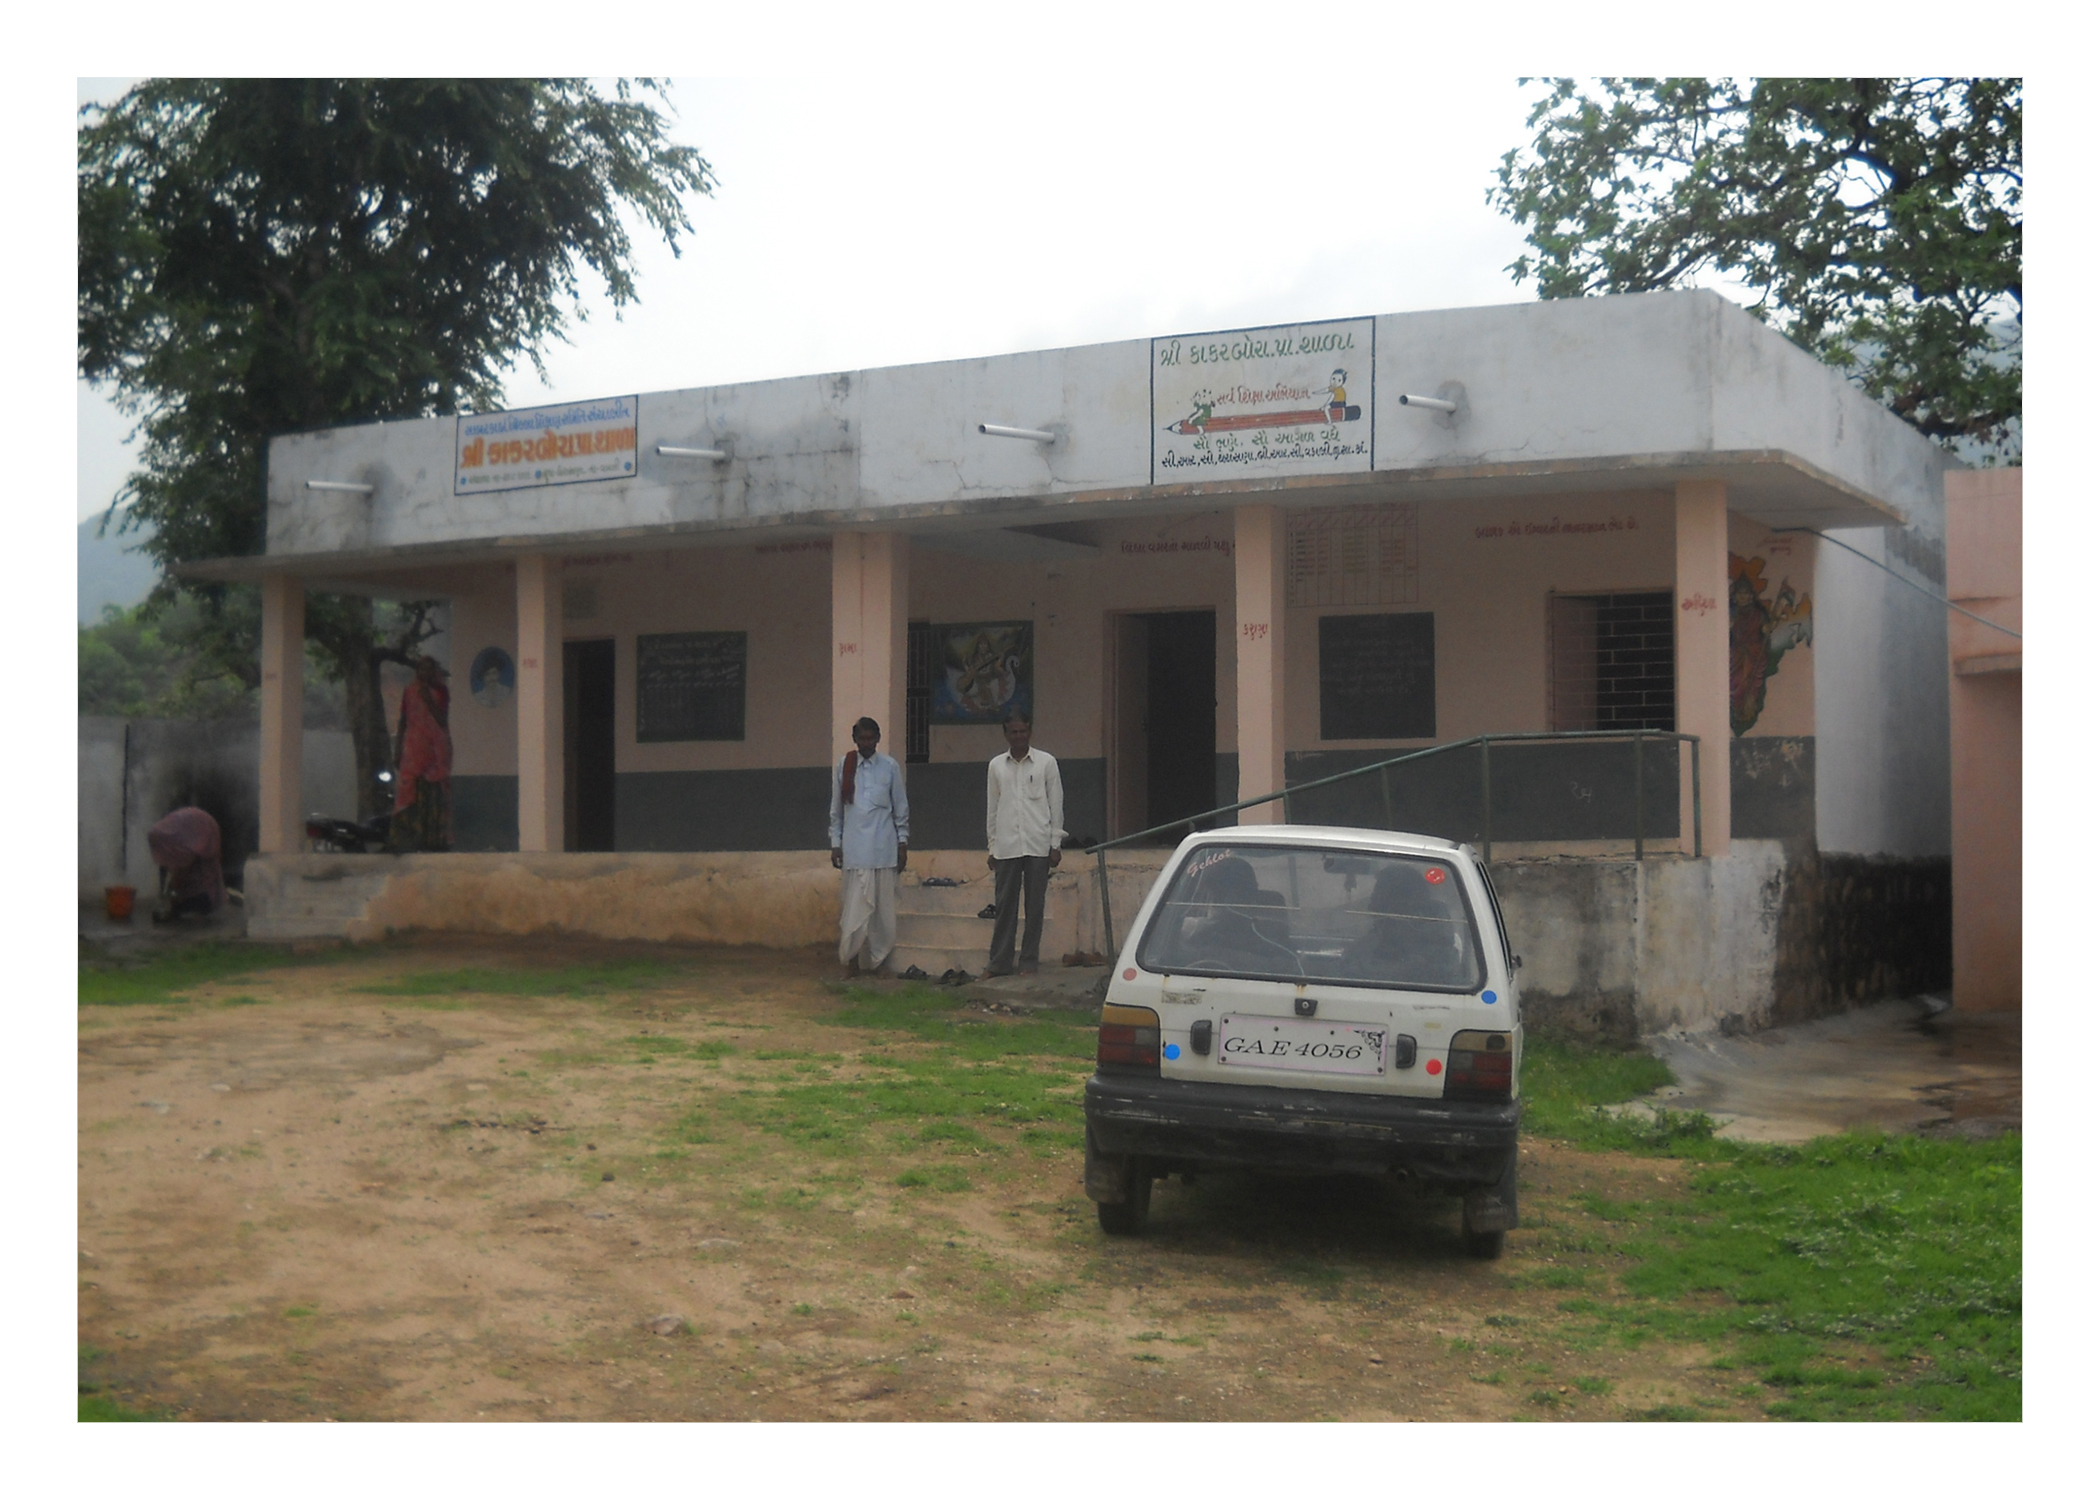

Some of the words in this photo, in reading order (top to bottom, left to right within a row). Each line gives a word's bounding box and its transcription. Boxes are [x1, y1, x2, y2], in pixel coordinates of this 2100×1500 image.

[1161, 340, 1181, 366] શ્રી
[461, 437, 484, 468] શ્રી
[1186, 848, 1231, 878] Gehlot
[1294, 1043, 1363, 1060] 4056
